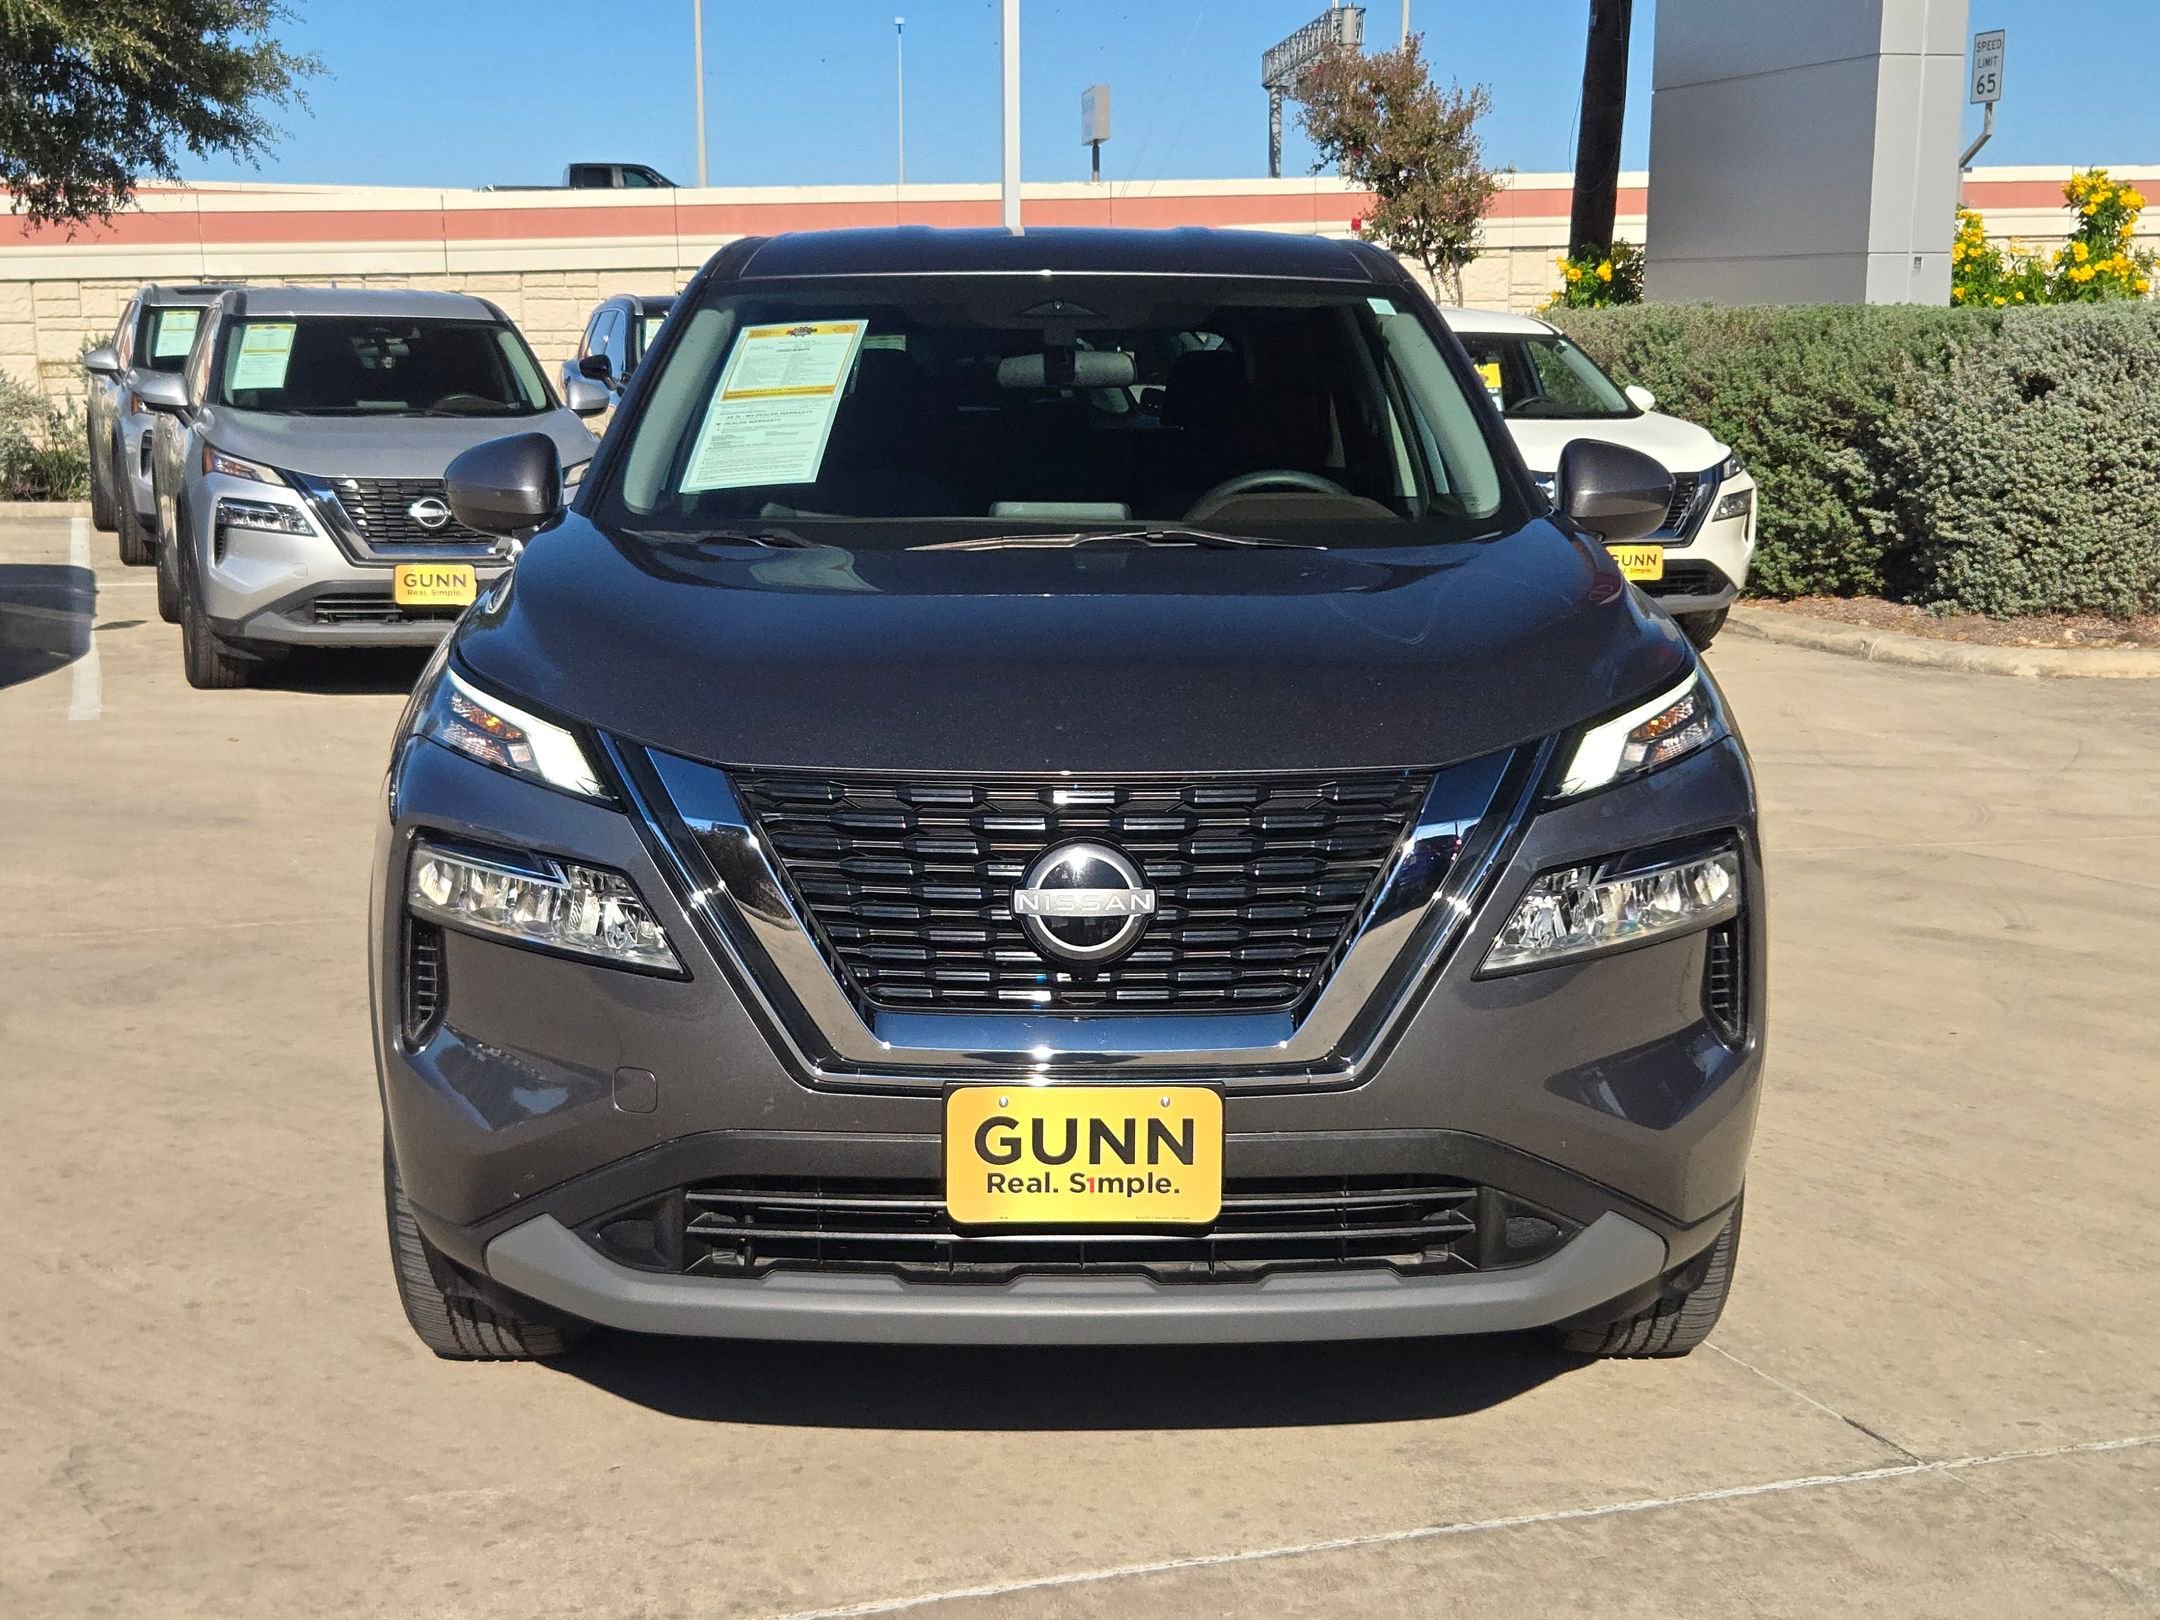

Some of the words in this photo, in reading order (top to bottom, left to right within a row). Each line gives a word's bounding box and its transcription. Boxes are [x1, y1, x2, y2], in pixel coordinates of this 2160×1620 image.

[1976, 39, 2002, 52] SPEED
[1977, 55, 1998, 69] LIMIT
[1976, 73, 1996, 95] 65
[404, 574, 467, 587] GUNN
[1019, 894, 1151, 911] NISSAN
[974, 1116, 1194, 1165] GUNN
[987, 1172, 1059, 1194] Real.
